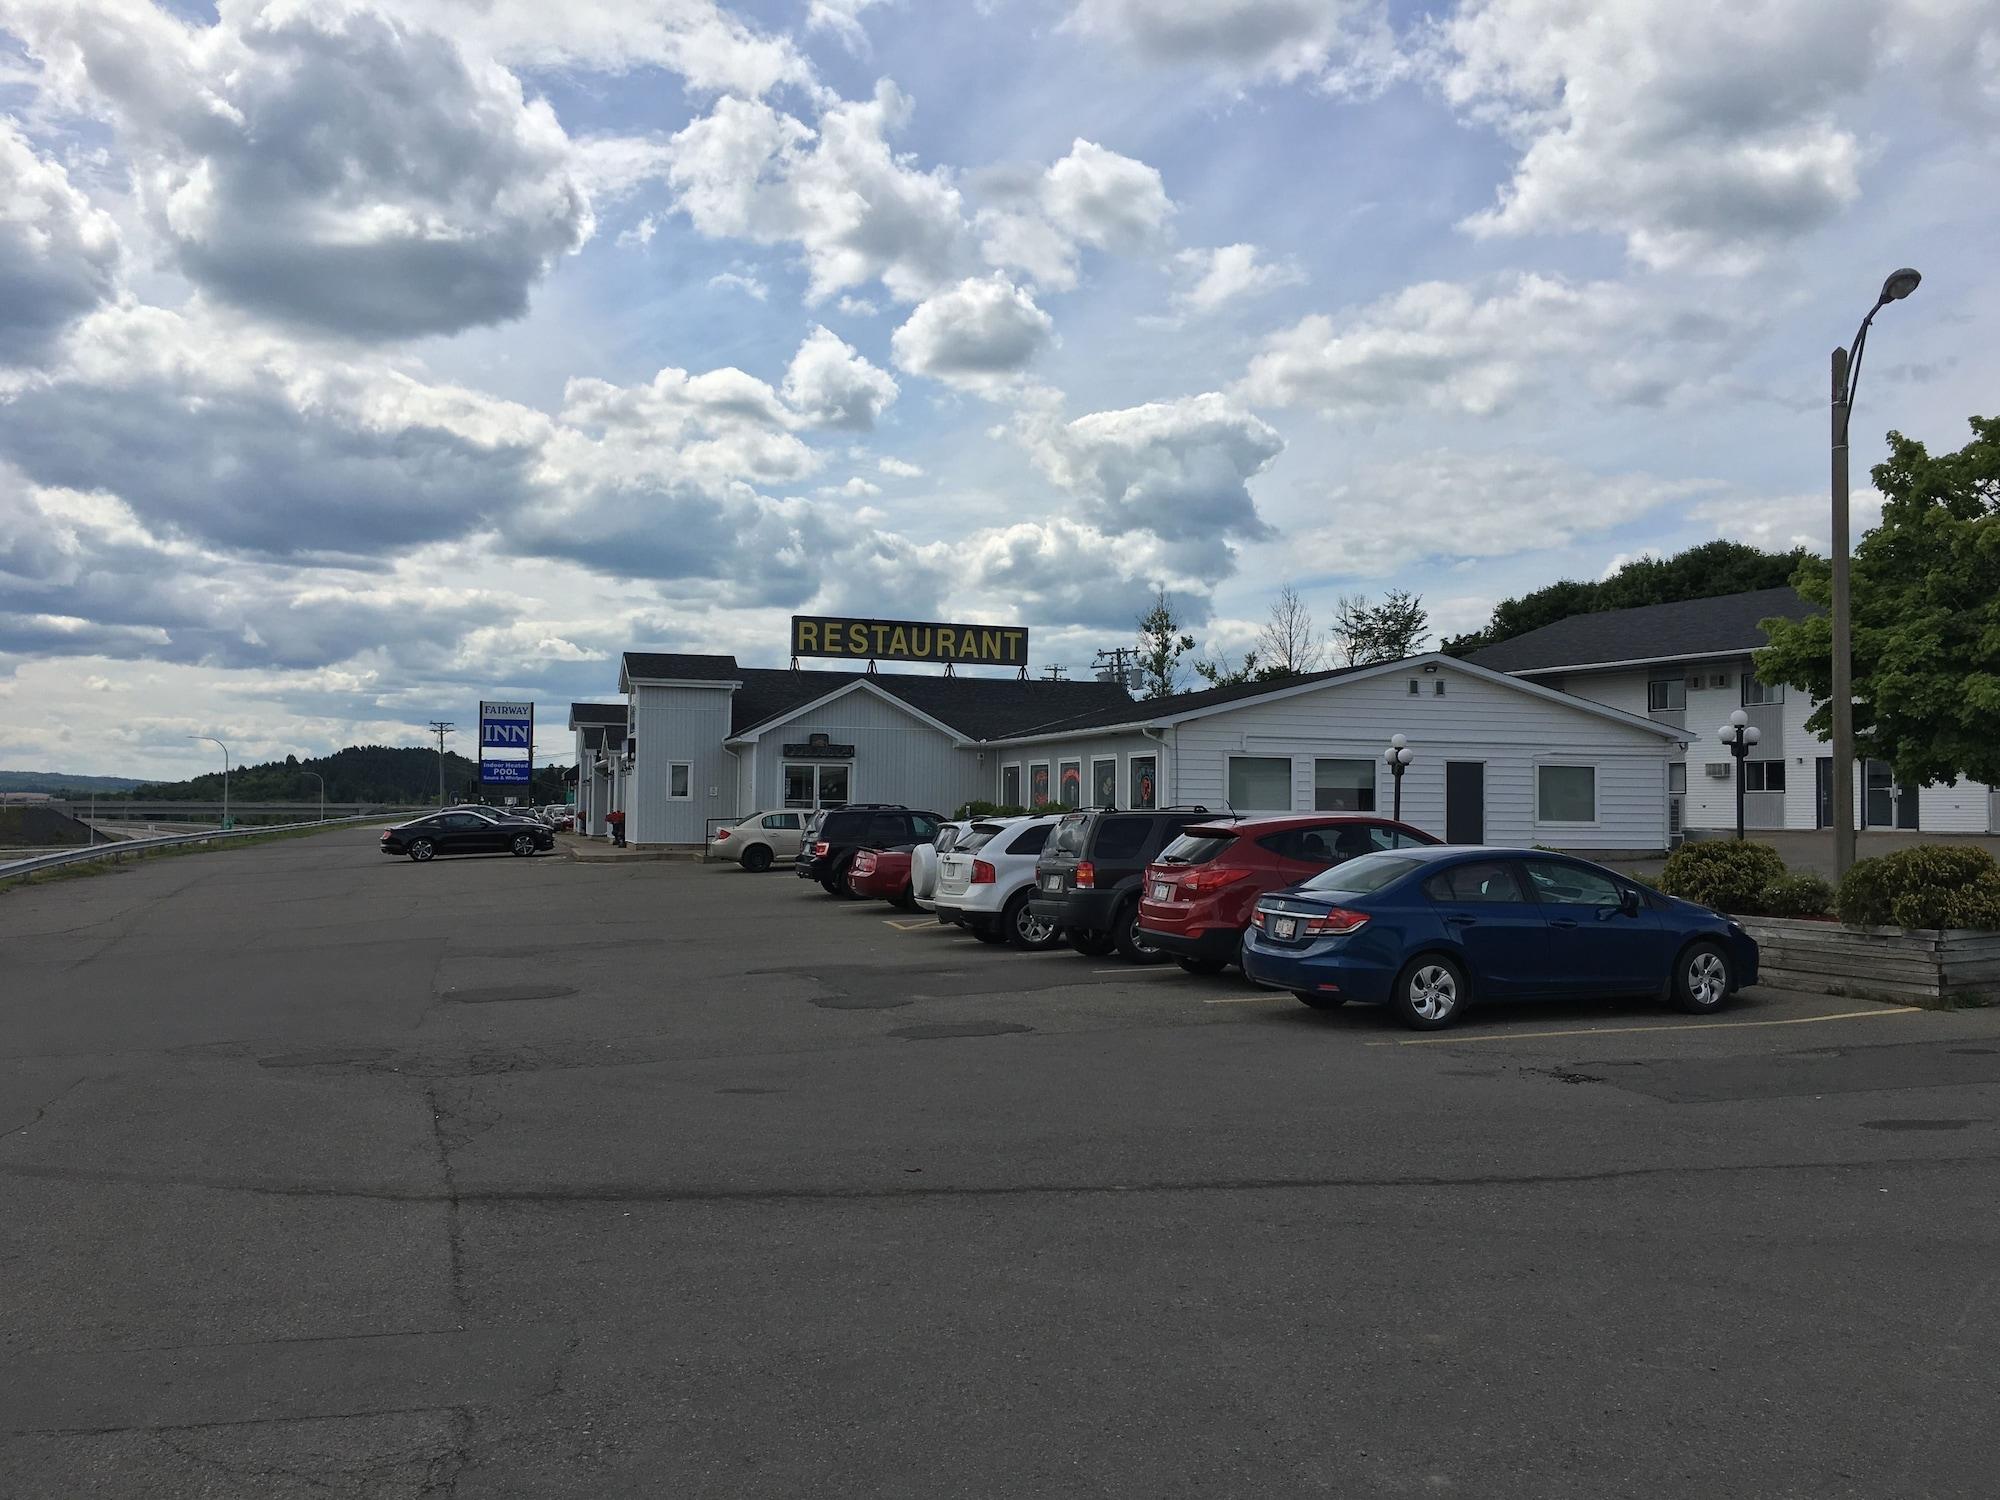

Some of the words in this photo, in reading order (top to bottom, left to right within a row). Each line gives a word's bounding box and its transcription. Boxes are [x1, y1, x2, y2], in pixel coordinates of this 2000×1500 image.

[798, 621, 1022, 660] RESTAURANT
[485, 705, 528, 714] FAIRWAY
[484, 725, 529, 742] INN
